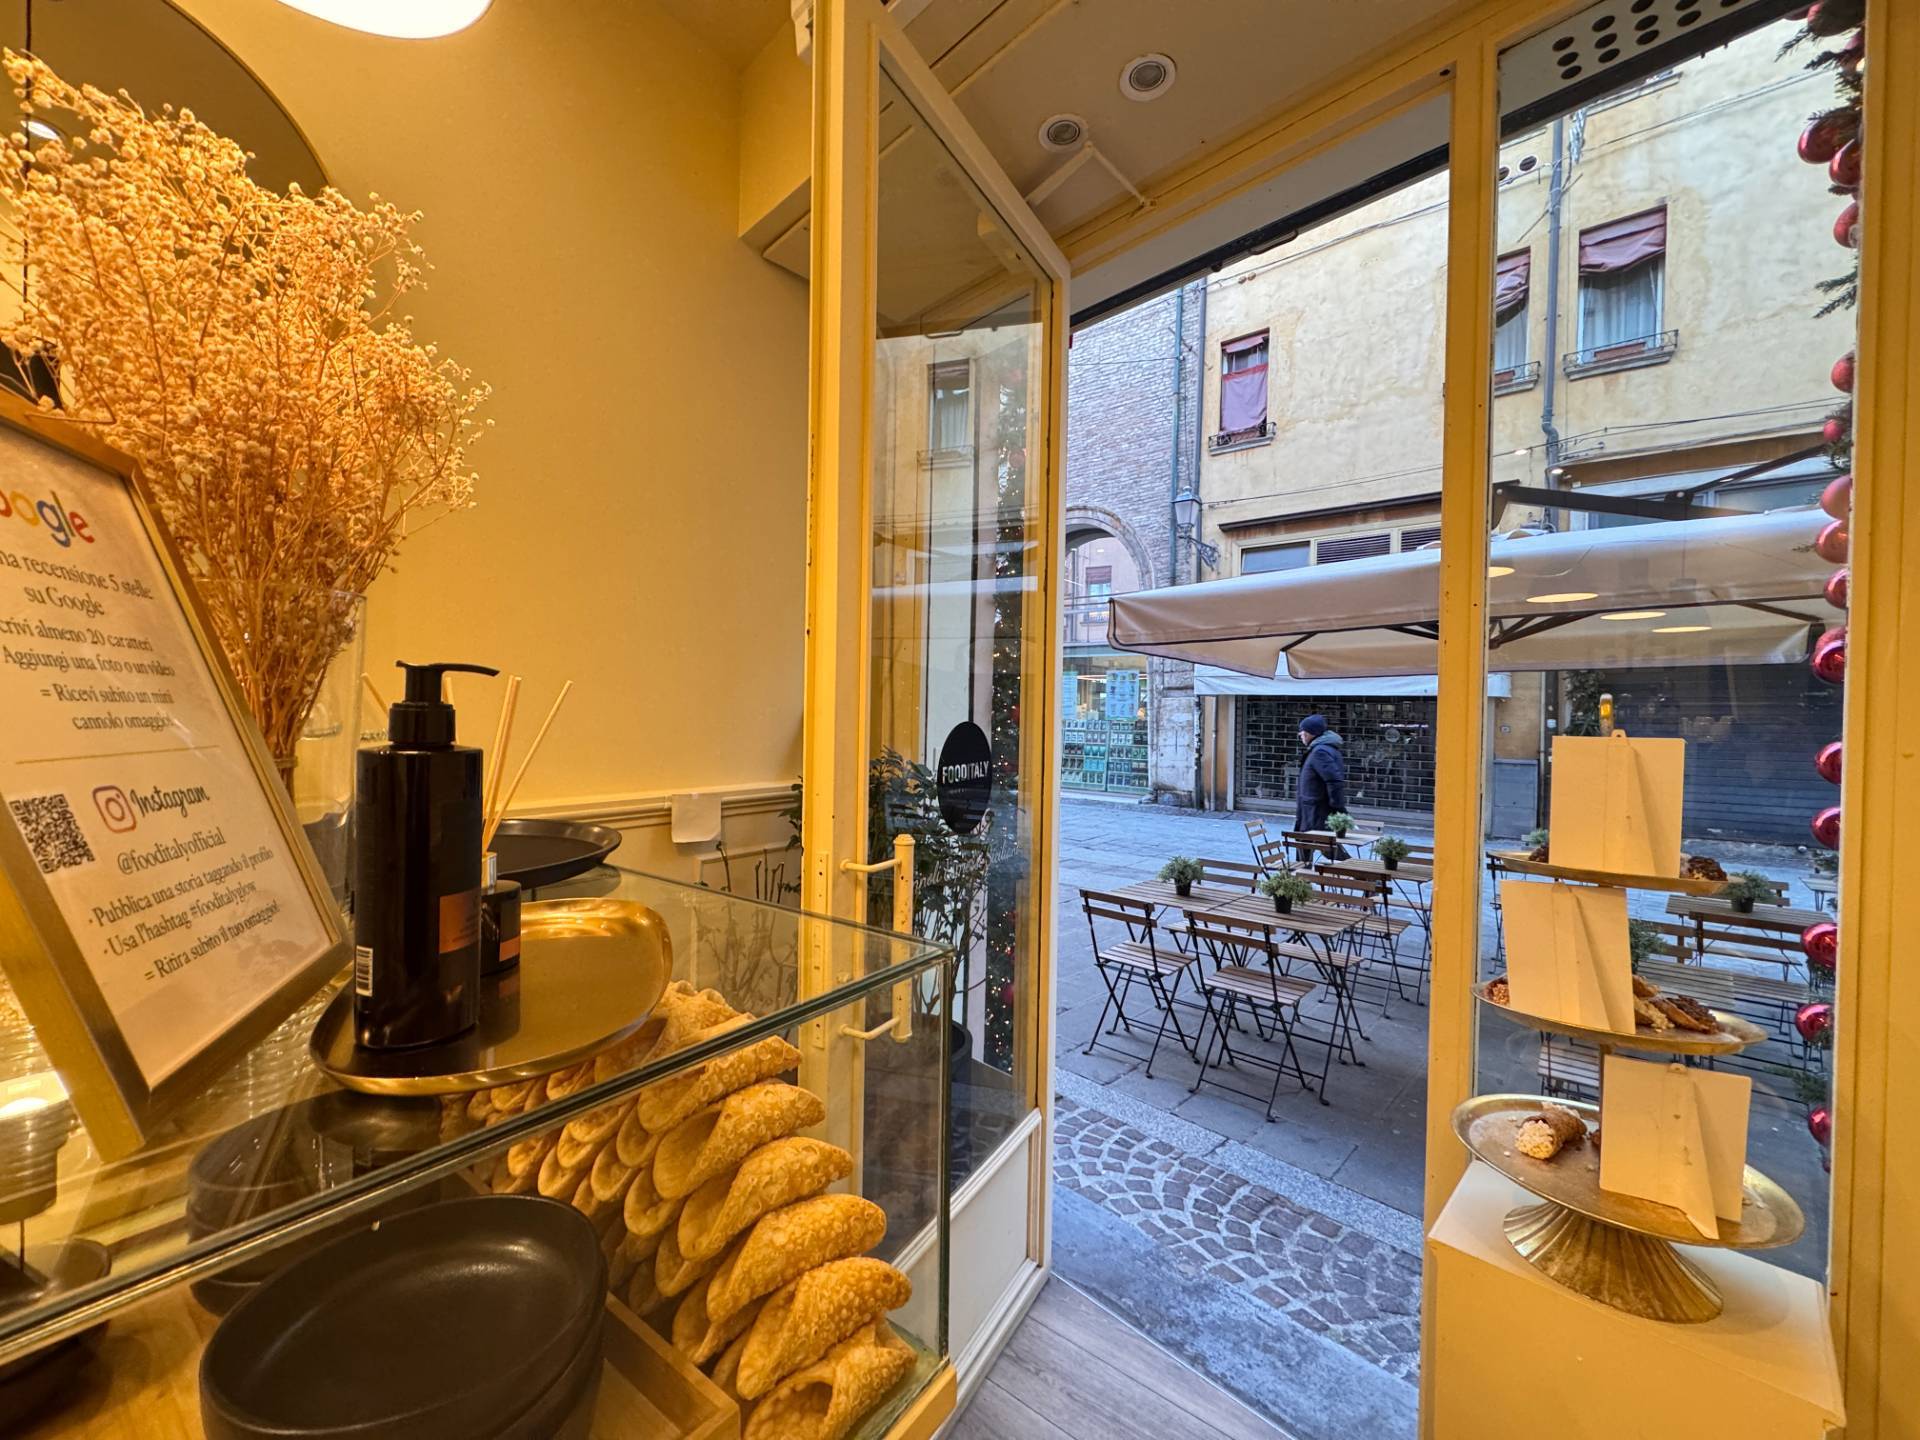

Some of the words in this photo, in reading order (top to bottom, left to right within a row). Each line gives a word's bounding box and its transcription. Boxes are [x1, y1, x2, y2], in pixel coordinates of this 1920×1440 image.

[23, 556, 107, 589] recensione
[109, 574, 120, 592] 5
[24, 586, 46, 605] su
[46, 587, 105, 618] Google
[35, 620, 87, 643] almeno
[87, 628, 106, 646] 20
[3, 646, 70, 673] Aggiungi
[71, 657, 96, 670] una
[96, 654, 123, 673] foto
[125, 662, 133, 673] o
[134, 662, 149, 675] un
[53, 683, 98, 702] Ricevi
[100, 686, 136, 704] subito
[137, 692, 150, 704] un
[72, 712, 122, 731] cannolo
[942, 760, 990, 784] FOODITALY
[129, 785, 211, 818] Instagram
[117, 827, 226, 875] @fooditalyofficial
[92, 894, 154, 927] Pubblica
[152, 887, 175, 905] una
[175, 873, 204, 897] storia
[203, 857, 244, 885] taggando
[241, 852, 250, 869] il
[107, 933, 139, 956] Usa
[154, 950, 191, 979] Ritira
[190, 934, 222, 960] subito
[218, 925, 229, 943] il
[227, 921, 245, 939] tuo
